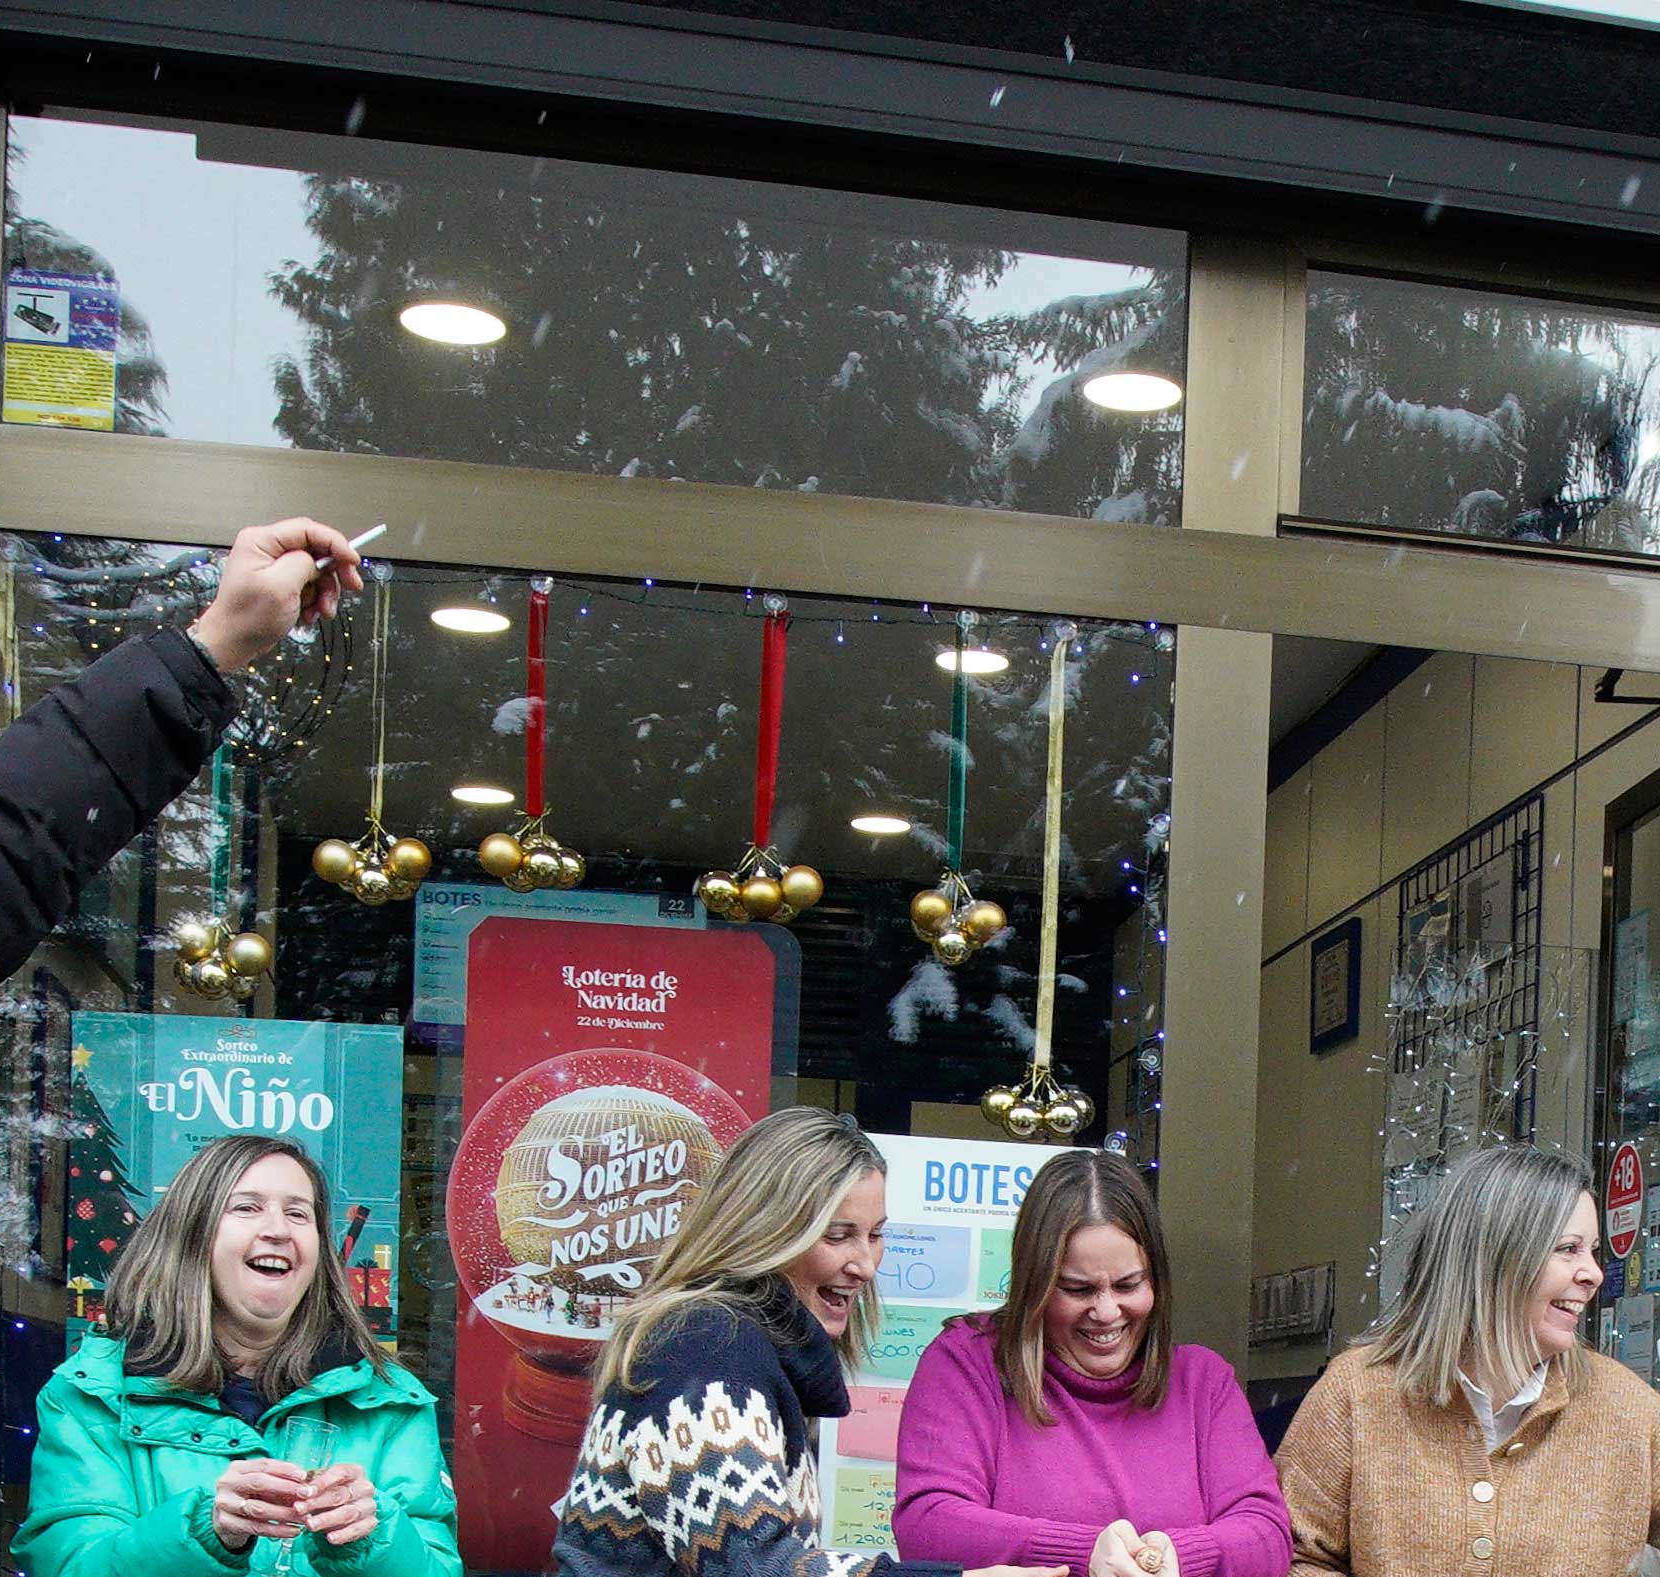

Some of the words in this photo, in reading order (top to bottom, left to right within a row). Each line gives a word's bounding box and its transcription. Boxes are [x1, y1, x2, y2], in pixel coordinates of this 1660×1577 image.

[422, 889, 481, 907] BOTES
[667, 899, 685, 912] 22
[561, 965, 646, 990] Lotería
[650, 970, 678, 991] de
[576, 989, 677, 1014] Navidad
[576, 1016, 591, 1027] 22
[592, 1016, 605, 1028] de
[606, 1017, 665, 1032] Diciembre
[180, 1048, 275, 1066] Extraordinario
[278, 1050, 293, 1065] de
[216, 1038, 258, 1052] Sorteo
[139, 1081, 176, 1113] El
[176, 1067, 334, 1134] Niño
[600, 1124, 644, 1157] EL
[537, 1135, 687, 1211] SORTEO
[924, 1160, 1033, 1207] BOTES
[1614, 1154, 1635, 1191] +18
[592, 1196, 630, 1218] QUE
[551, 1224, 610, 1270] NOS
[615, 1201, 683, 1250] UNE
